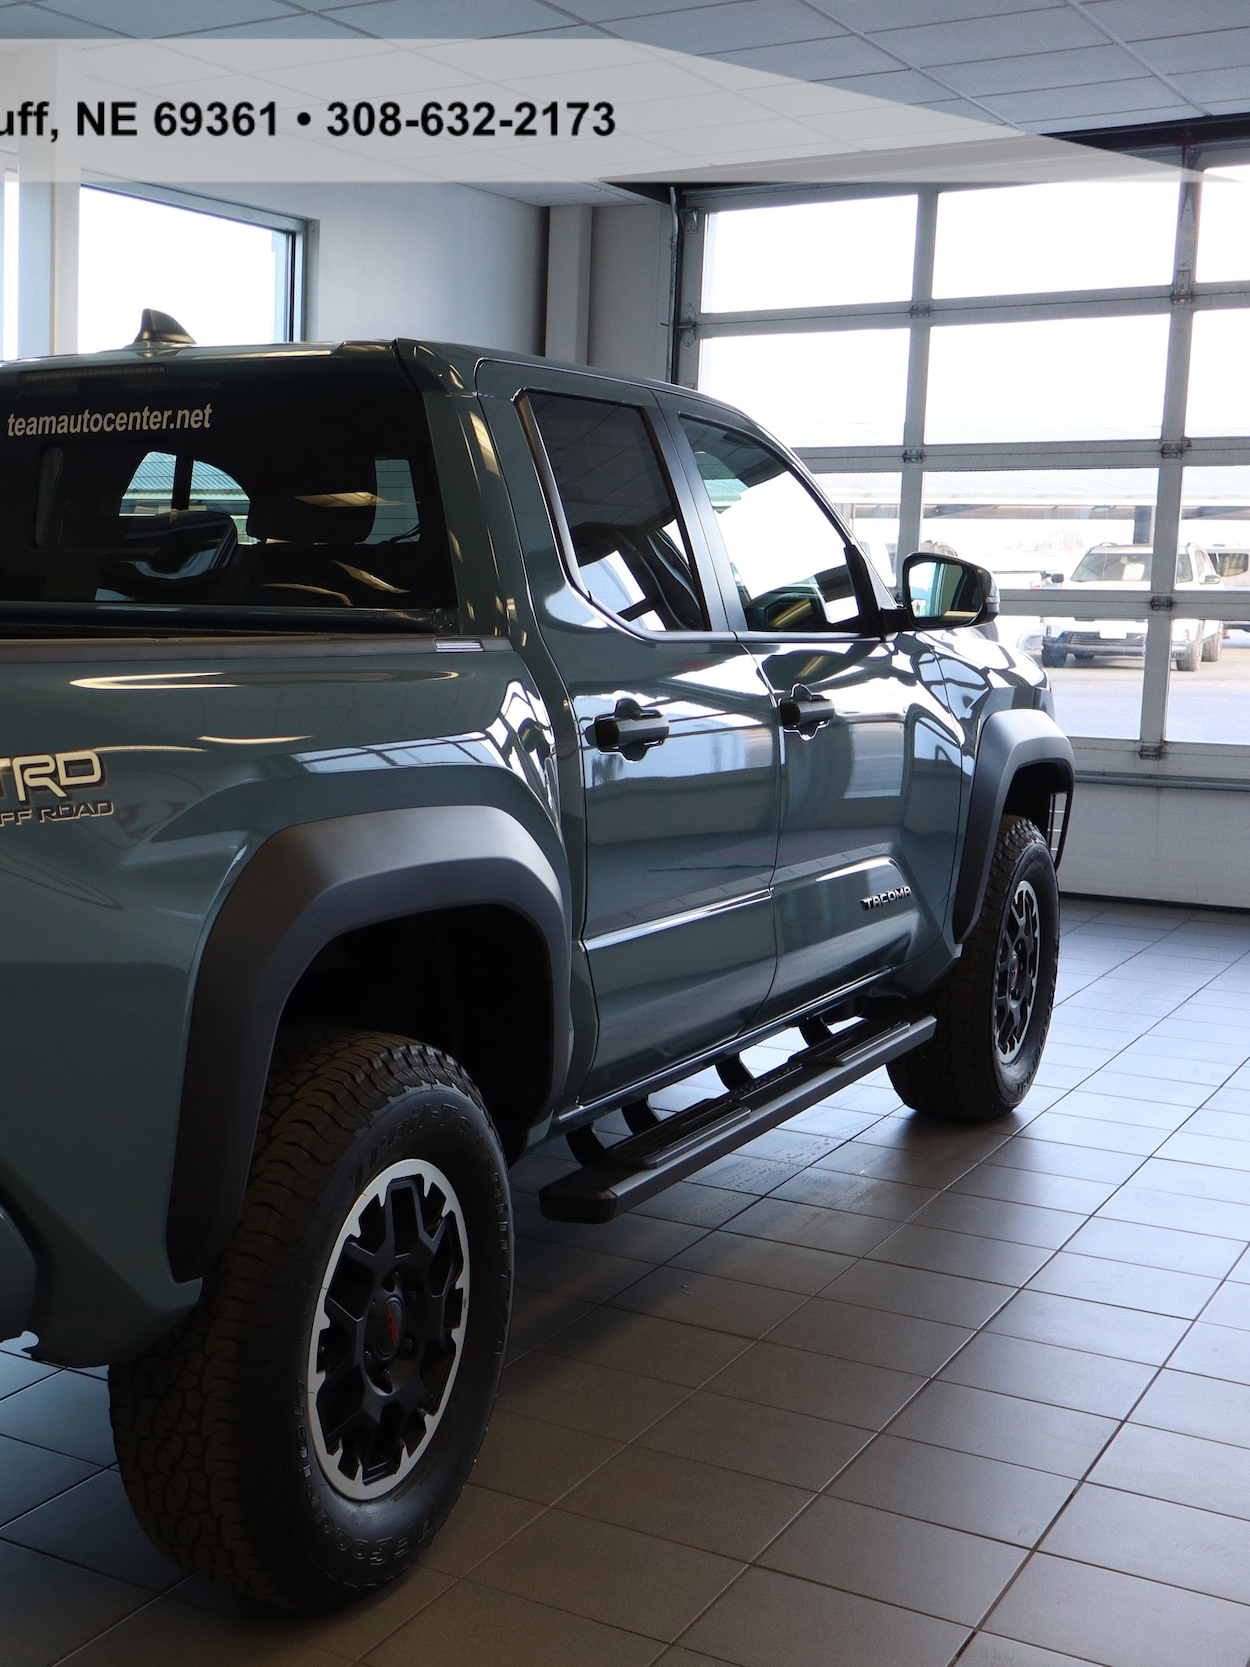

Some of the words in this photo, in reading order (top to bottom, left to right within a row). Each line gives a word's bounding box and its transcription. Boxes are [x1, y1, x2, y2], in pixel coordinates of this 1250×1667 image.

[7, 402, 213, 437] teamautocenter.net
[38, 801, 115, 824] ROAD
[860, 885, 912, 910] TACOMA
